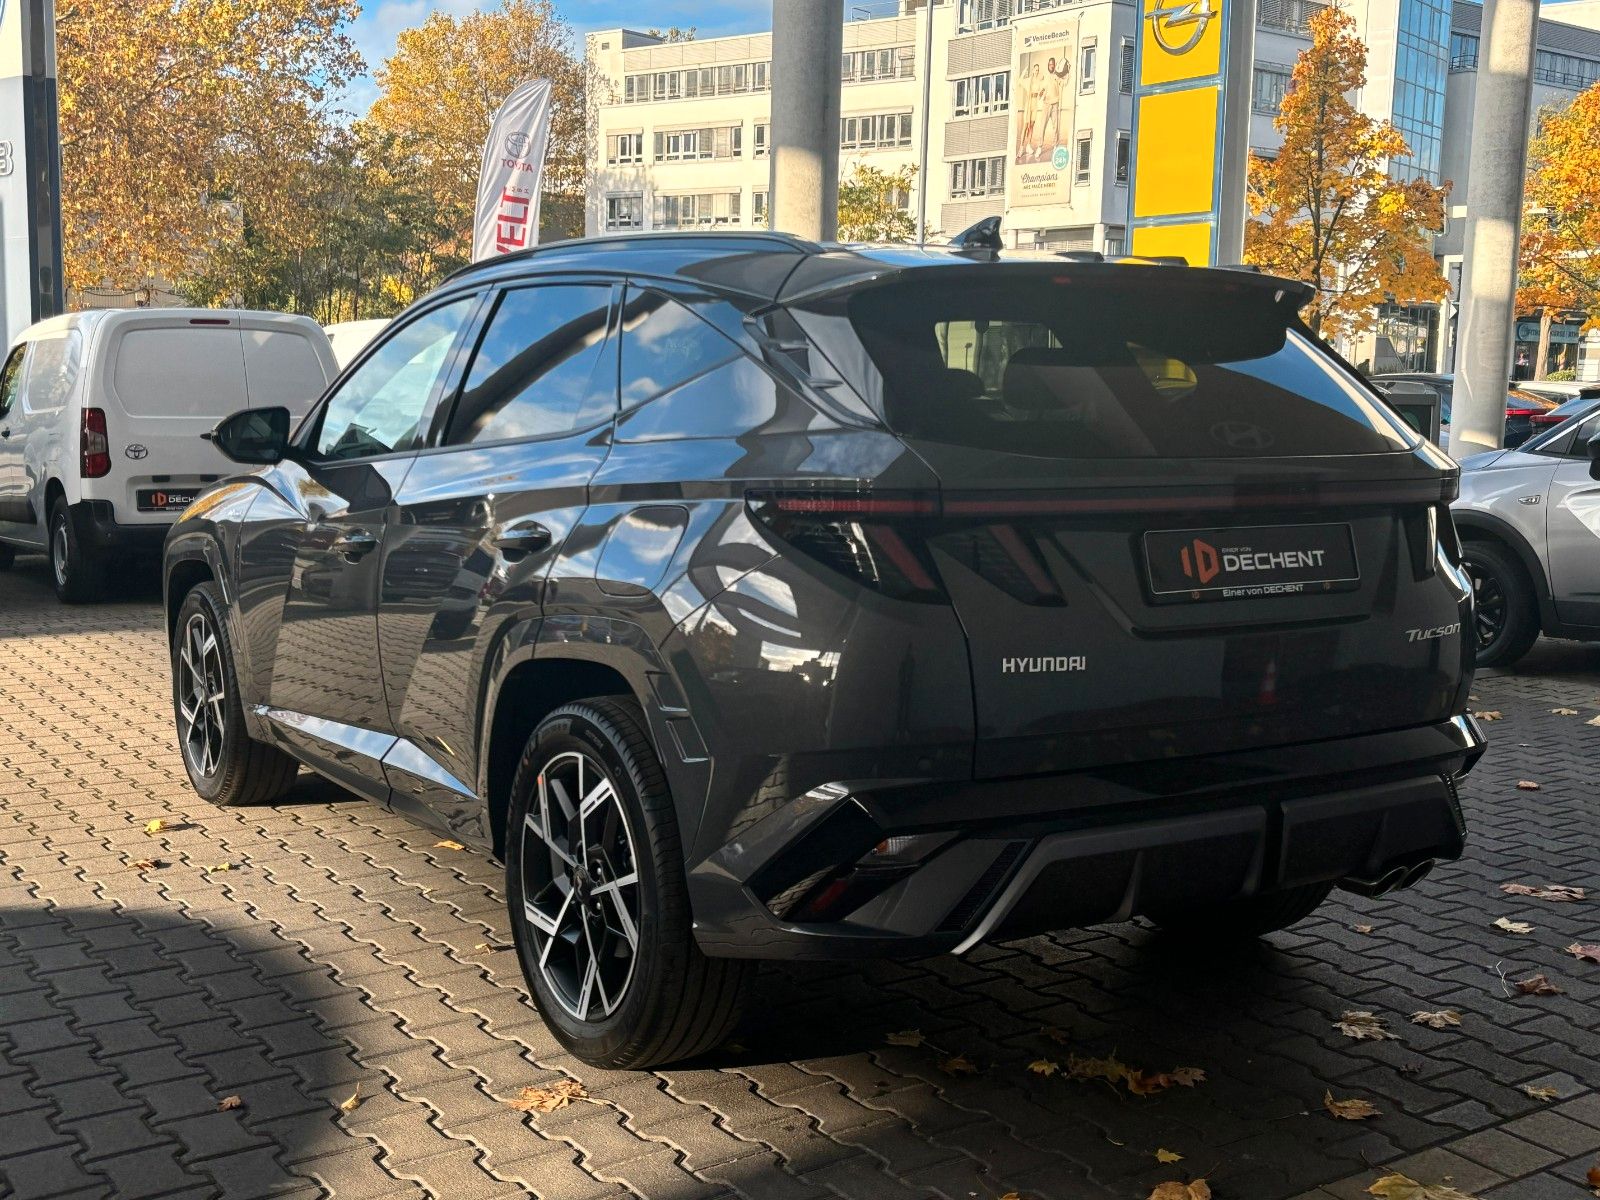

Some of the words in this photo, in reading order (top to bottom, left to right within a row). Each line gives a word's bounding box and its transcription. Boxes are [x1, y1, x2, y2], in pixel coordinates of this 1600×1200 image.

[496, 186, 529, 254] ELT
[1223, 550, 1325, 572] DECHENT
[1222, 588, 1246, 597] Einer
[1247, 587, 1263, 596] von
[1263, 584, 1304, 594] DECHENT
[1002, 656, 1086, 673] HYUNDAI
